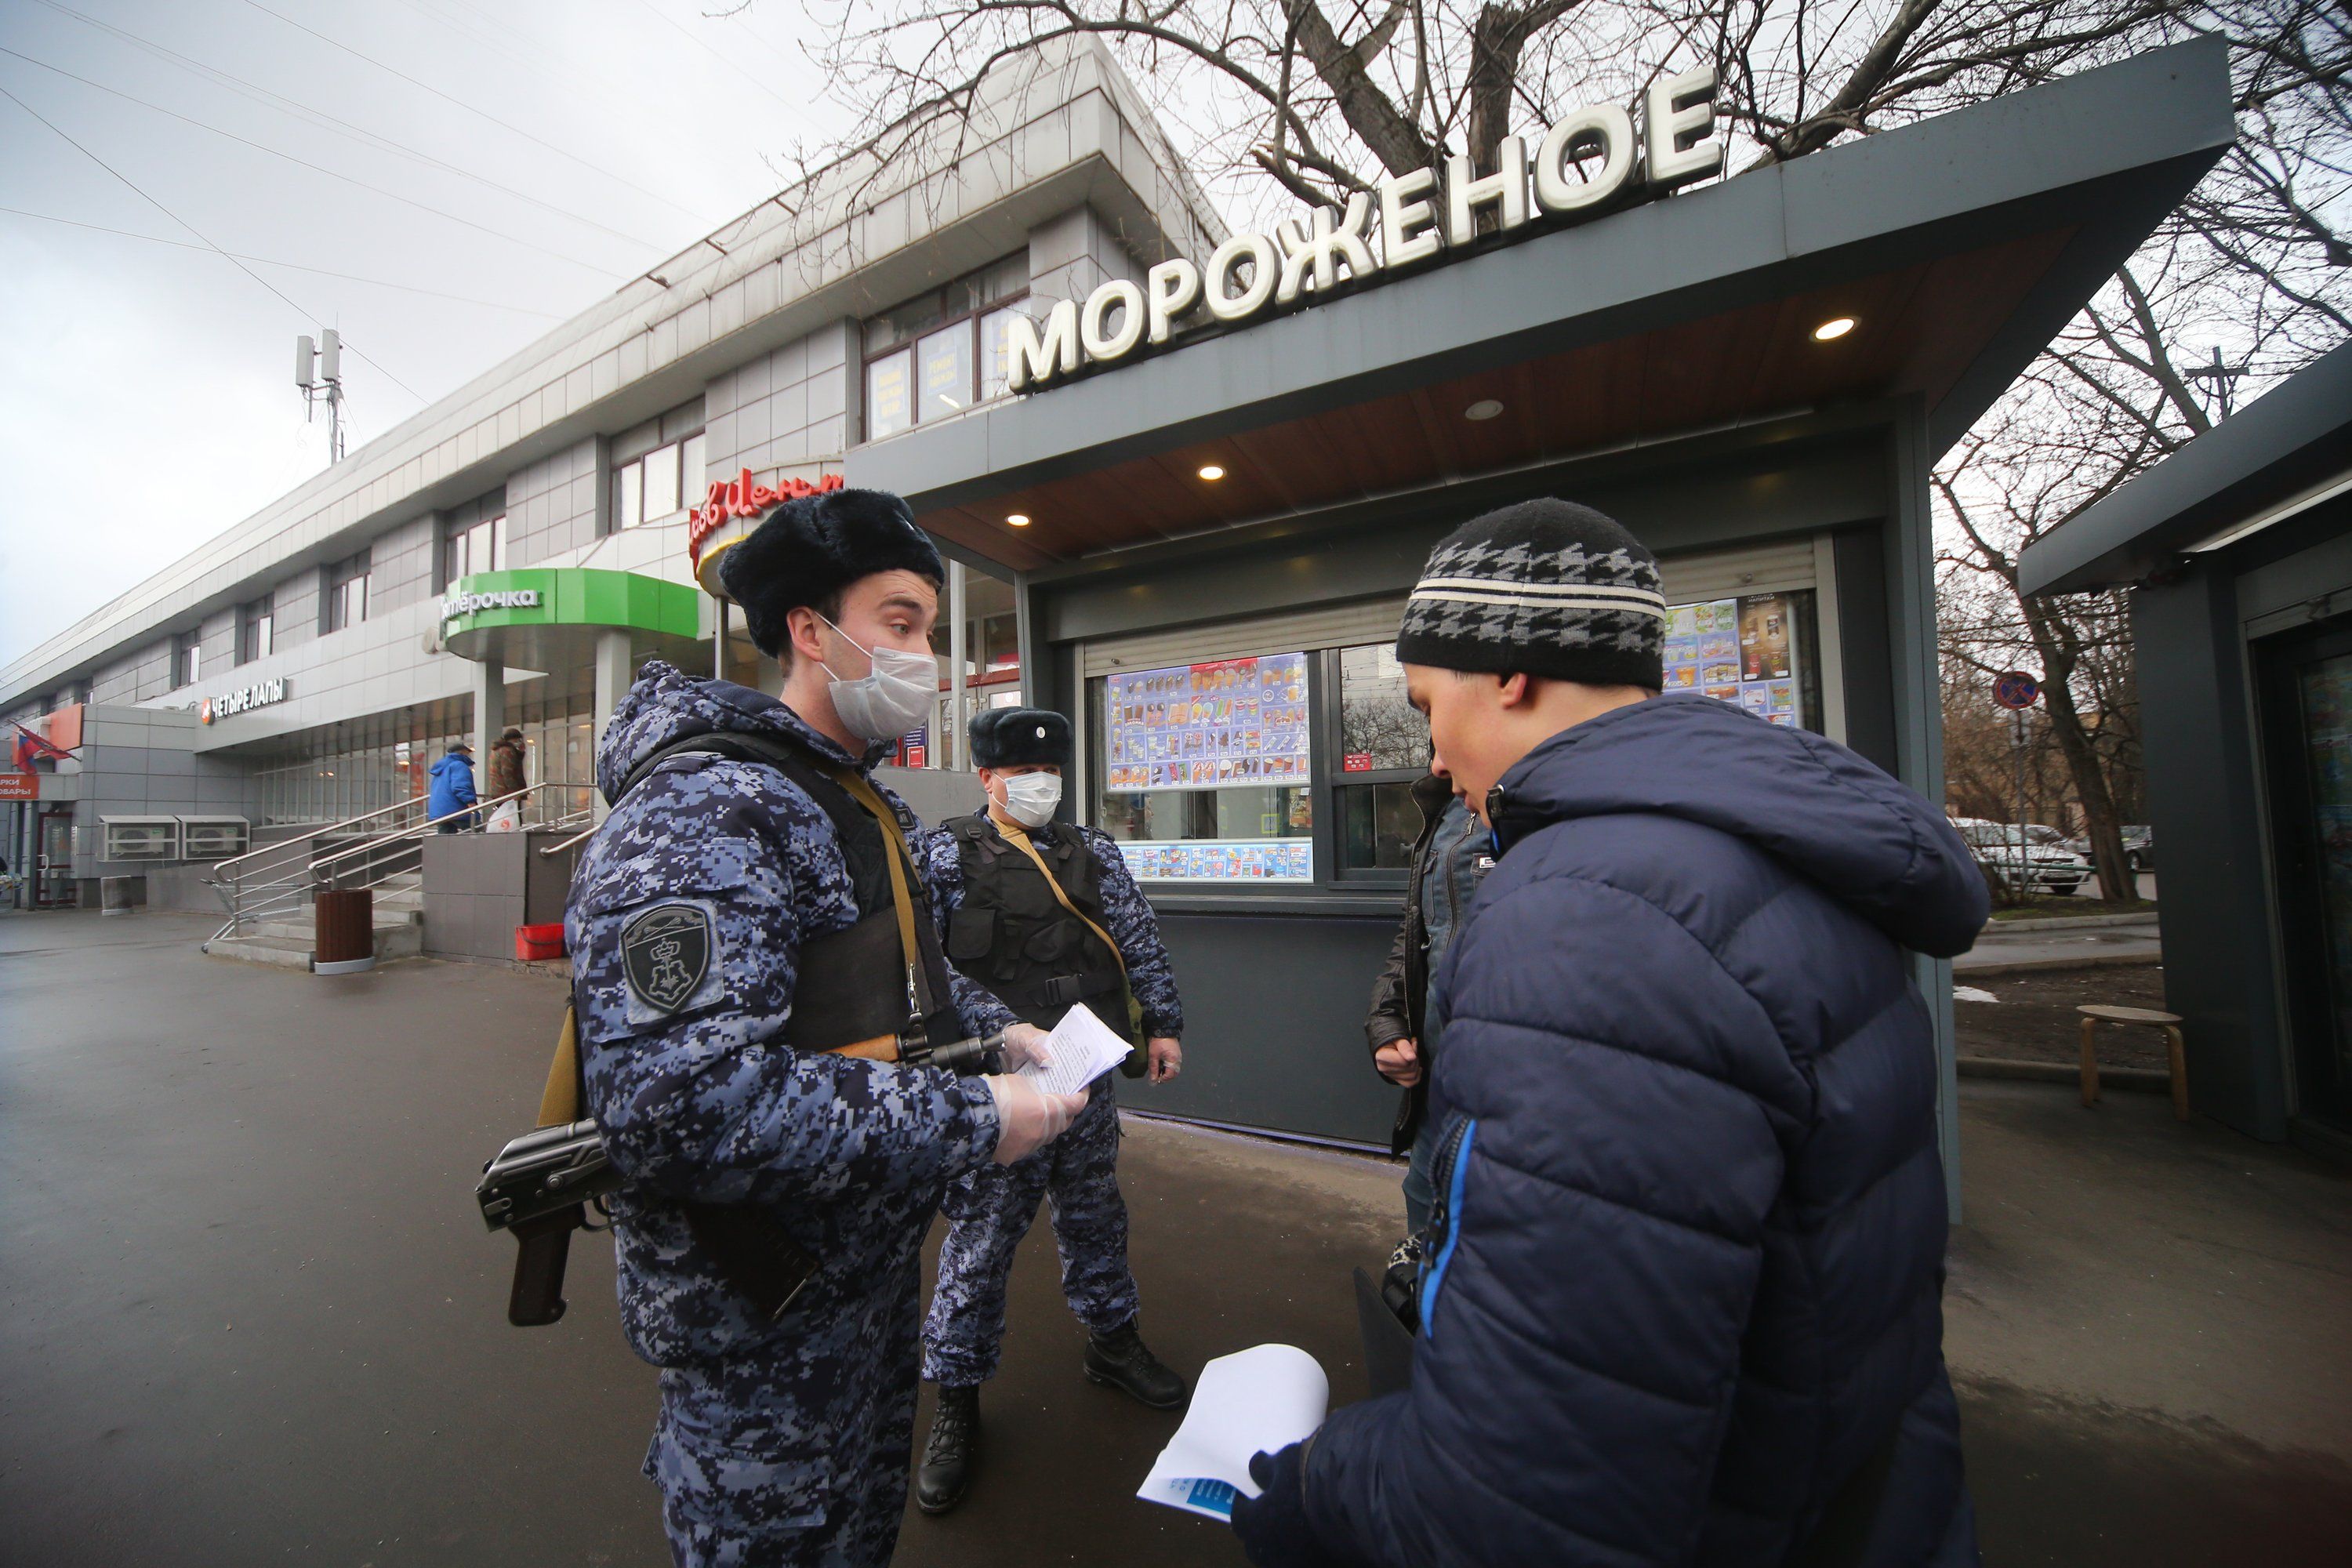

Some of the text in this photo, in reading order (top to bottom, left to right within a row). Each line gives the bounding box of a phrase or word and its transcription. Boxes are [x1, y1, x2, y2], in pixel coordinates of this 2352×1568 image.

[1007, 65, 1722, 394] МОРОЖЕНОЕ
[212, 677, 284, 718] ЧЕТЫРЕ ЛАПЫ
